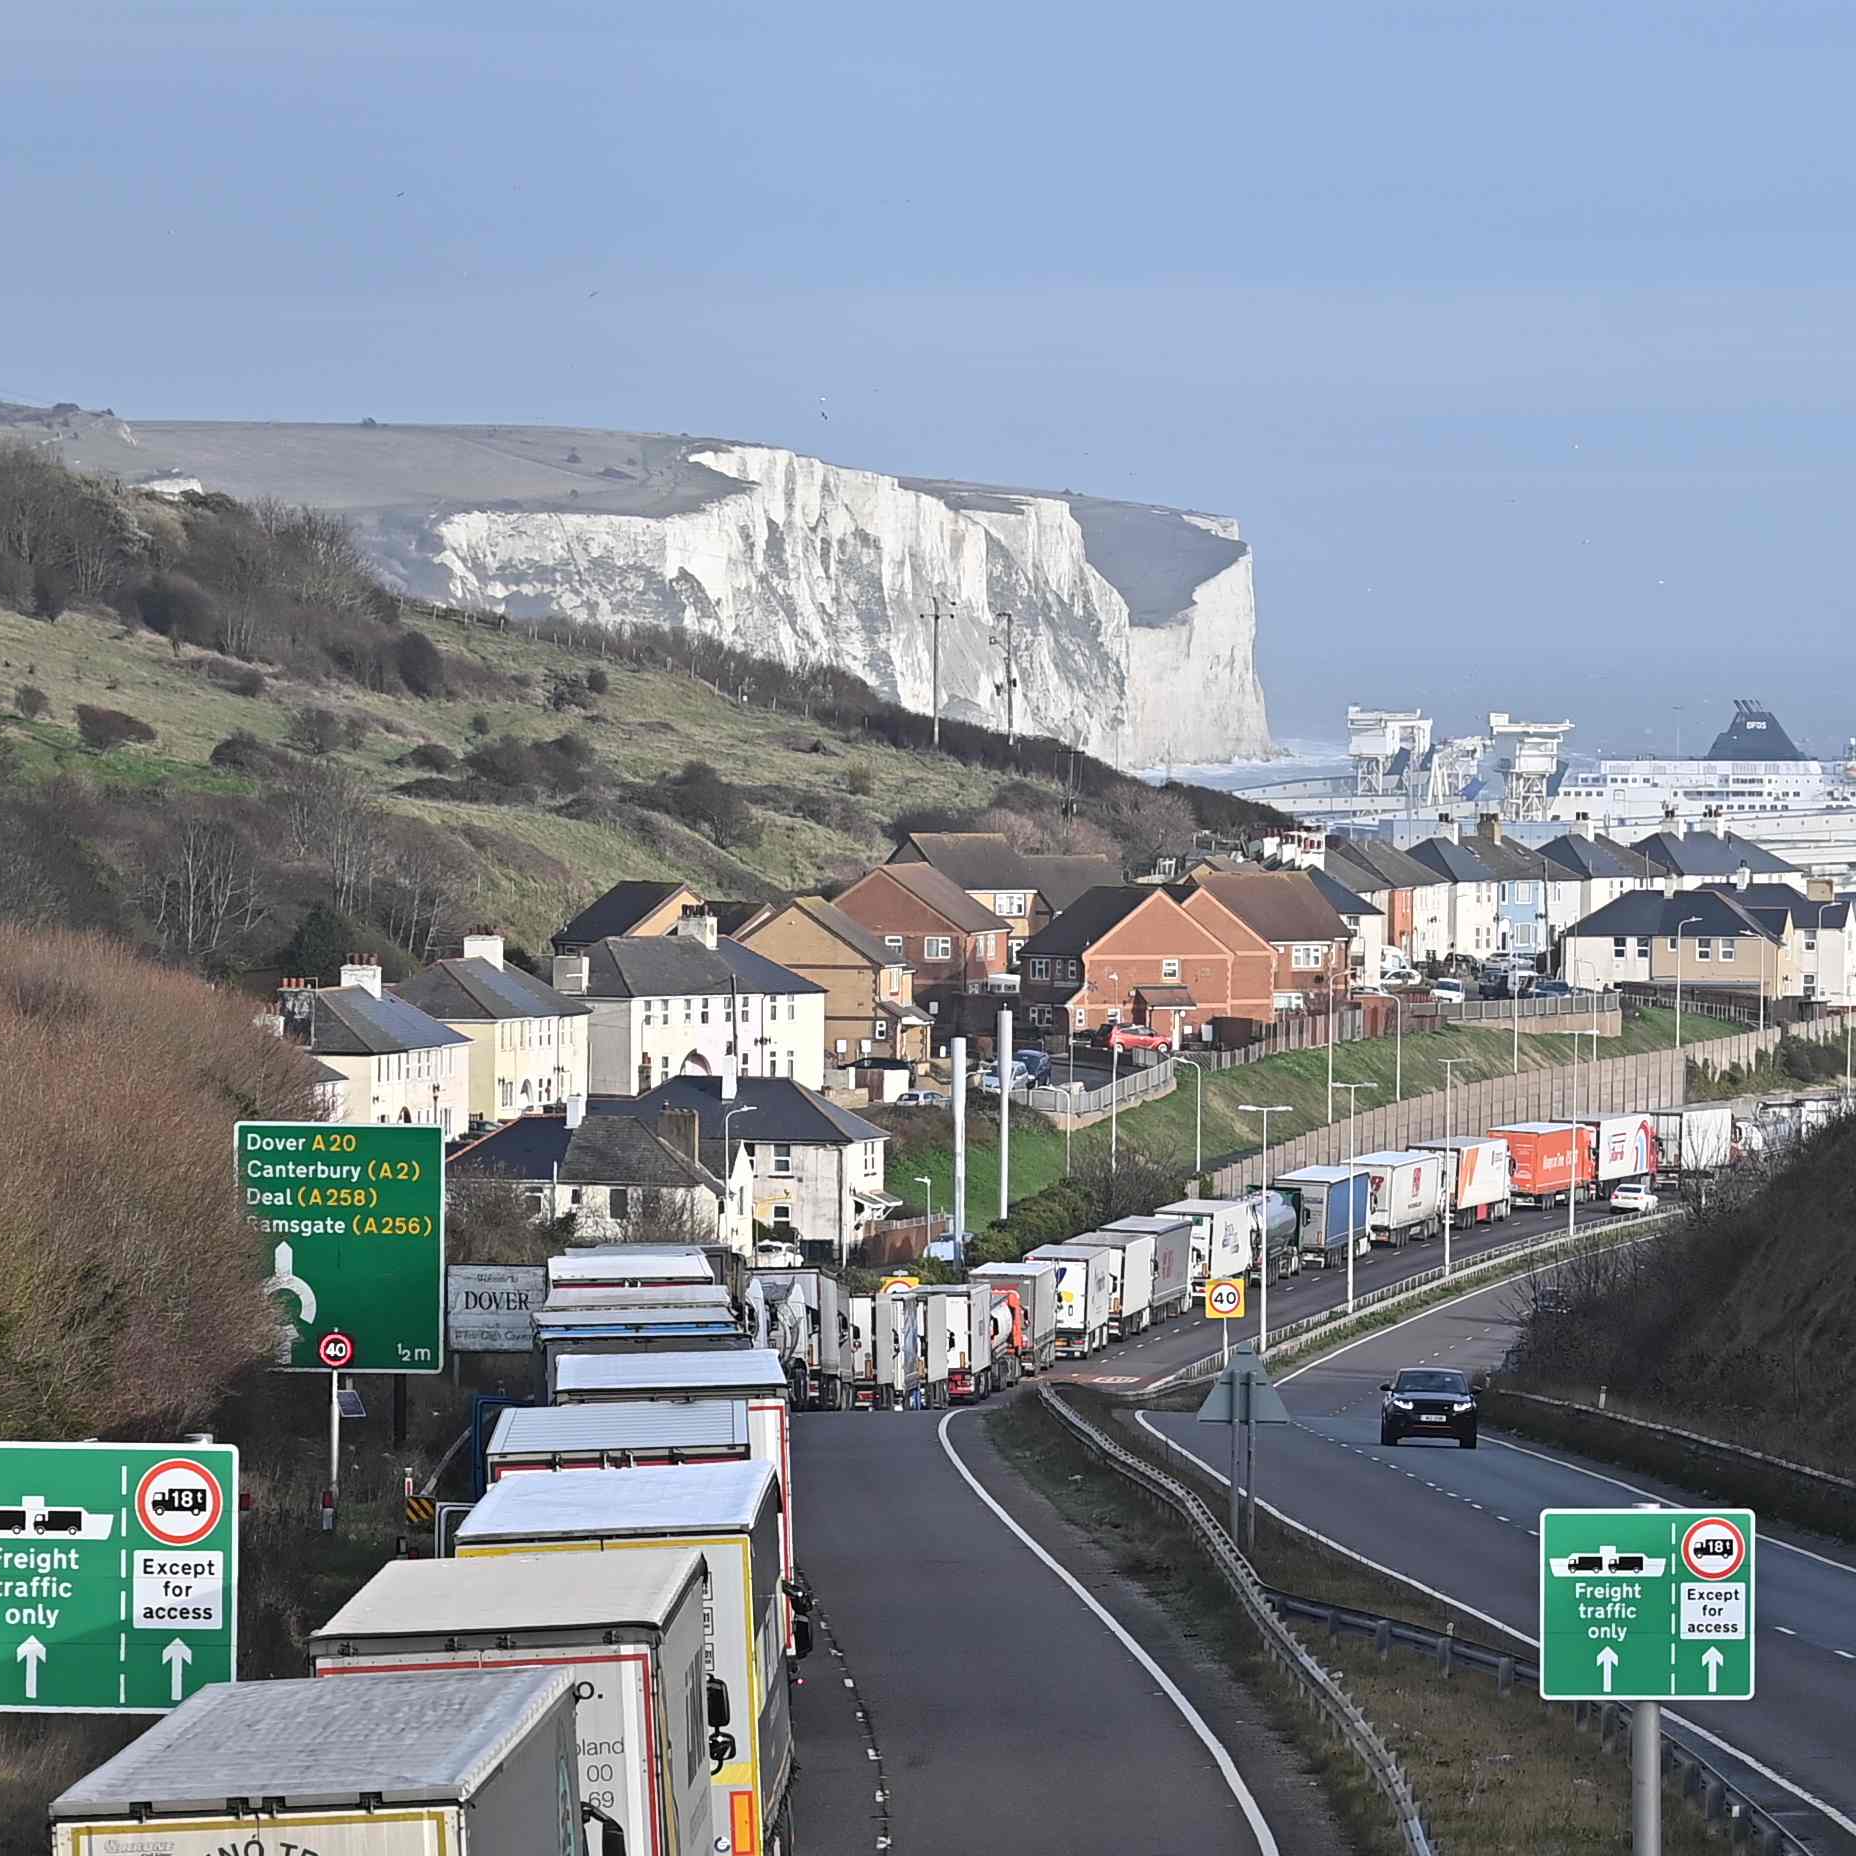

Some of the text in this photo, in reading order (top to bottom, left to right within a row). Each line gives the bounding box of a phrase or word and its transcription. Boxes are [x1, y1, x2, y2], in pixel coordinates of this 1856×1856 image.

[246, 1133, 357, 1152] Dover A20
[247, 1160, 422, 1183] Canterbury (A2)
[246, 1188, 379, 1208] Deal (A258)
[352, 1216, 432, 1237] (A256)
[464, 1291, 529, 1310] DOVER
[1214, 1291, 1236, 1304] 40
[324, 1343, 346, 1357] 40
[143, 1558, 215, 1581] Except
[163, 1580, 192, 1597] for
[1575, 1582, 1642, 1601] Freight
[1687, 1588, 1739, 1603] Except
[5, 1604, 59, 1629] only
[143, 1604, 213, 1620] access
[1578, 1603, 1637, 1619] traffic
[1702, 1604, 1724, 1617] for
[1587, 1623, 1627, 1642] only
[1687, 1621, 1738, 1633] access
